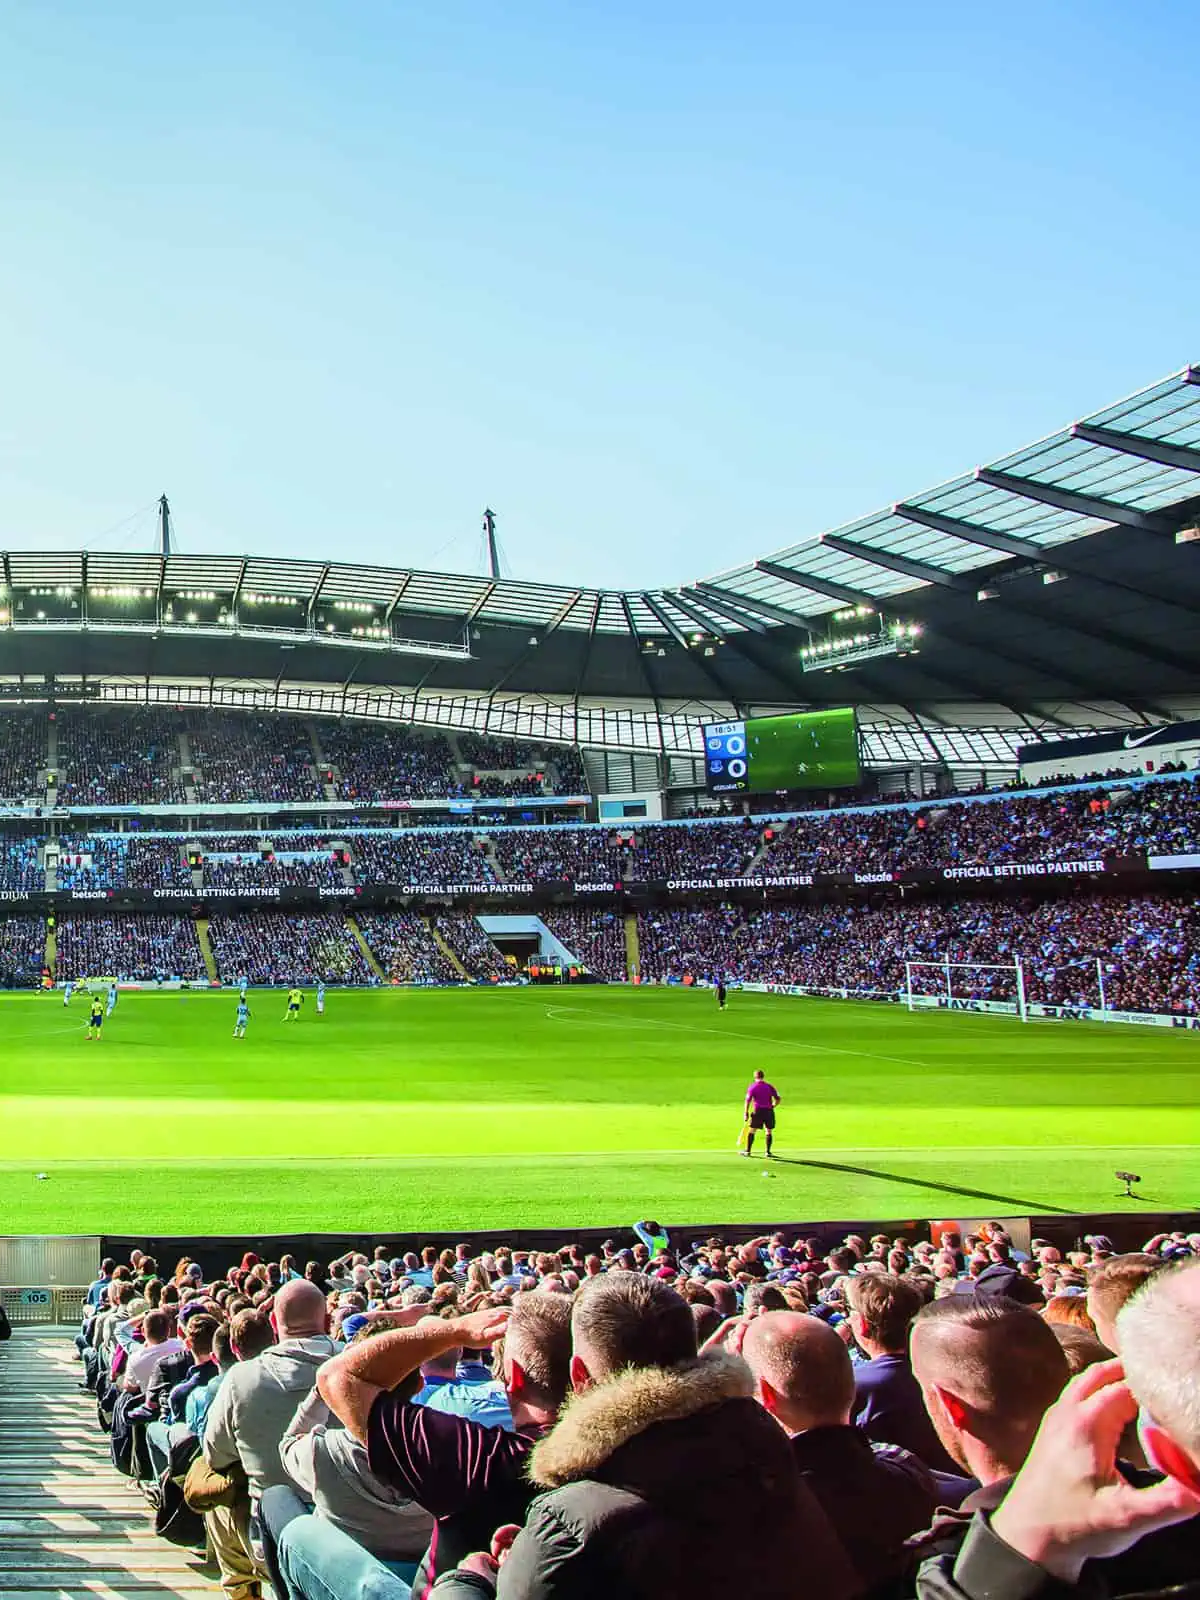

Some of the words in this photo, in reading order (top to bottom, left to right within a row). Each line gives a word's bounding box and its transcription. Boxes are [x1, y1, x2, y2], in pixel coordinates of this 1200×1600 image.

[726, 736, 745, 755] 0
[728, 759, 747, 778] 0
[943, 865, 992, 880] OFFICIAL
[994, 863, 1046, 877] BETTING
[1047, 860, 1105, 874] PARTNER
[666, 878, 715, 889] OFFICIAL
[717, 877, 764, 888] BETTING
[765, 875, 813, 887] PARTNER
[854, 871, 893, 884] betsafe
[319, 886, 355, 896] betsafe
[402, 885, 445, 894] OFFICIAL
[447, 884, 488, 894] BETTING
[490, 883, 534, 893] PARTNER
[574, 881, 614, 892] betsafe
[72, 889, 107, 899] betsafe
[153, 889, 195, 898] OFFICIAL
[197, 888, 236, 898] BETTING
[238, 887, 280, 897] PARTNER
[27, 1294, 48, 1303] 105
